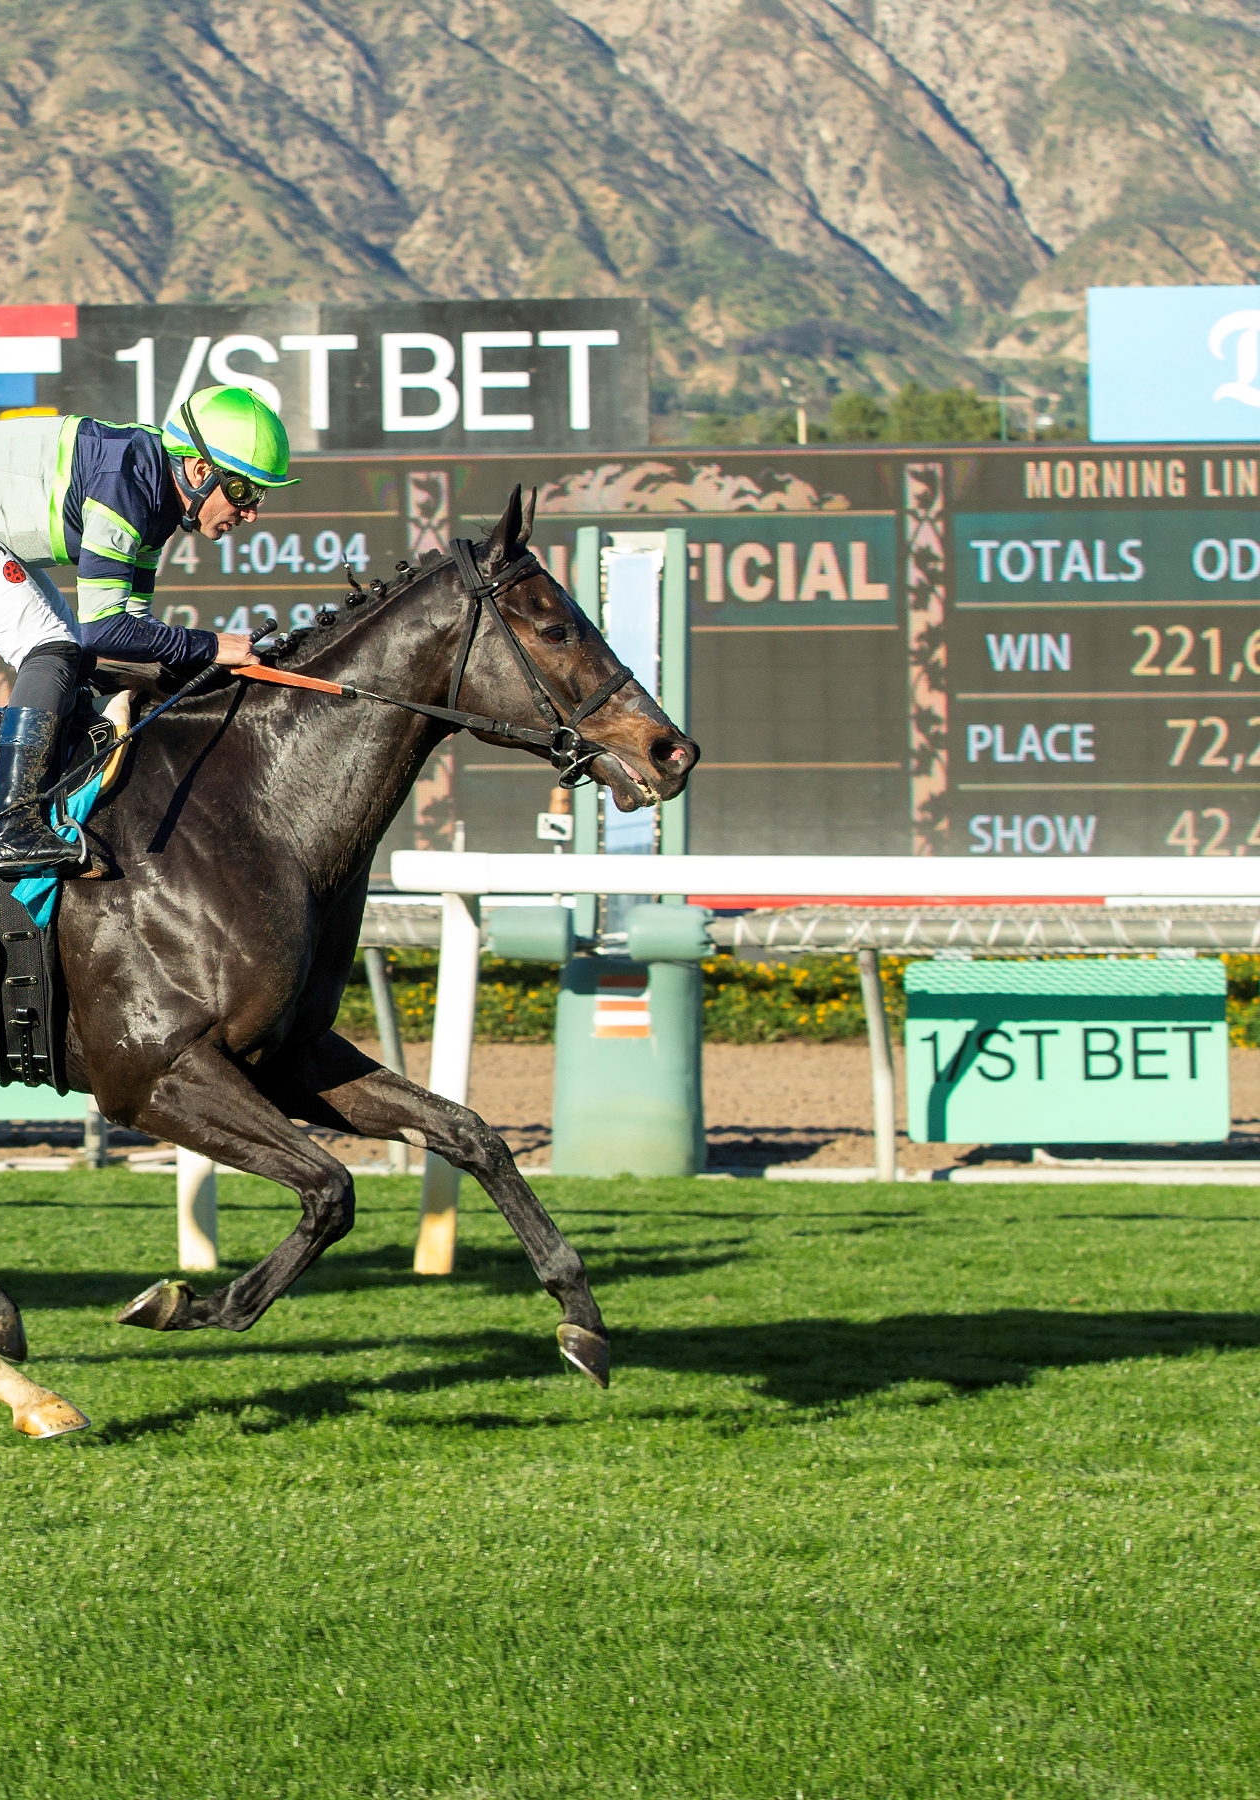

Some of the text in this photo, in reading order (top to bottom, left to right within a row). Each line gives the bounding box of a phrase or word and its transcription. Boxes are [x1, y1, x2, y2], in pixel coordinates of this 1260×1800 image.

[381, 330, 620, 433] BET
[1025, 459, 1186, 499] MORNING
[214, 529, 371, 575] 1:04.94
[969, 538, 1144, 584] TOTALS
[986, 633, 1072, 673] WIN
[967, 724, 1095, 763] PLACE
[968, 815, 1097, 854] SHOW
[920, 1026, 1213, 1083] 1/ST BET
